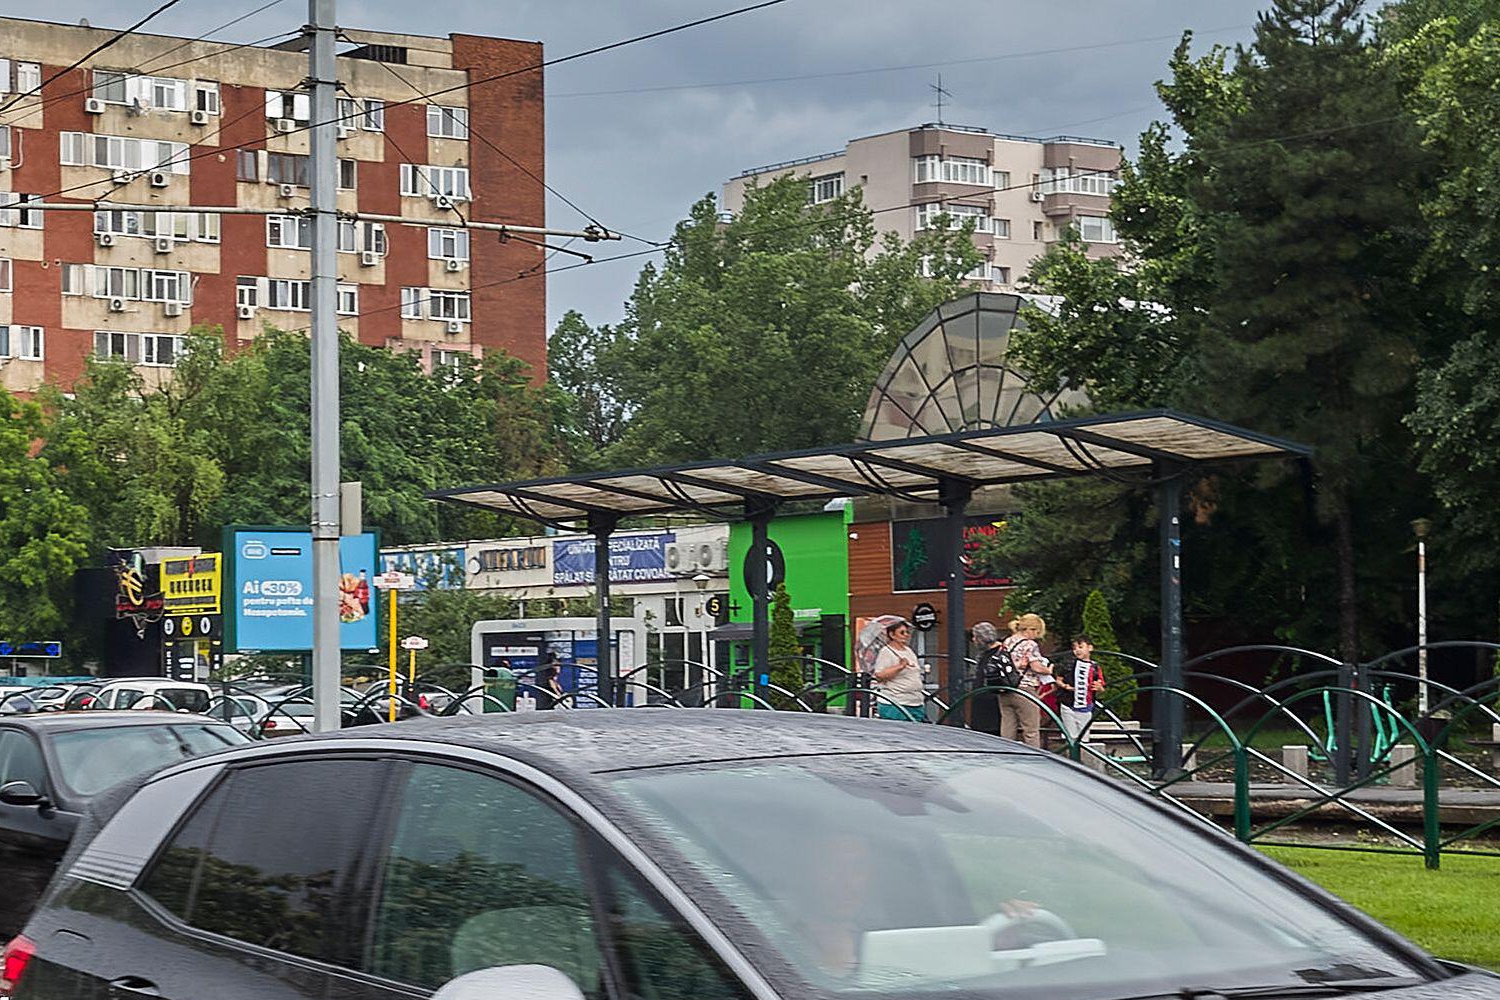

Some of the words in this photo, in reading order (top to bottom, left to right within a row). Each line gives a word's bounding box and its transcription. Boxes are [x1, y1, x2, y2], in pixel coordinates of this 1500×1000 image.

[567, 540, 596, 555] UNITAT
[608, 536, 660, 552] PECIALIZATĂ
[609, 555, 630, 566] NTRU
[243, 580, 260, 594] Ai
[264, 582, 299, 593] -30%
[710, 599, 720, 612] 5
